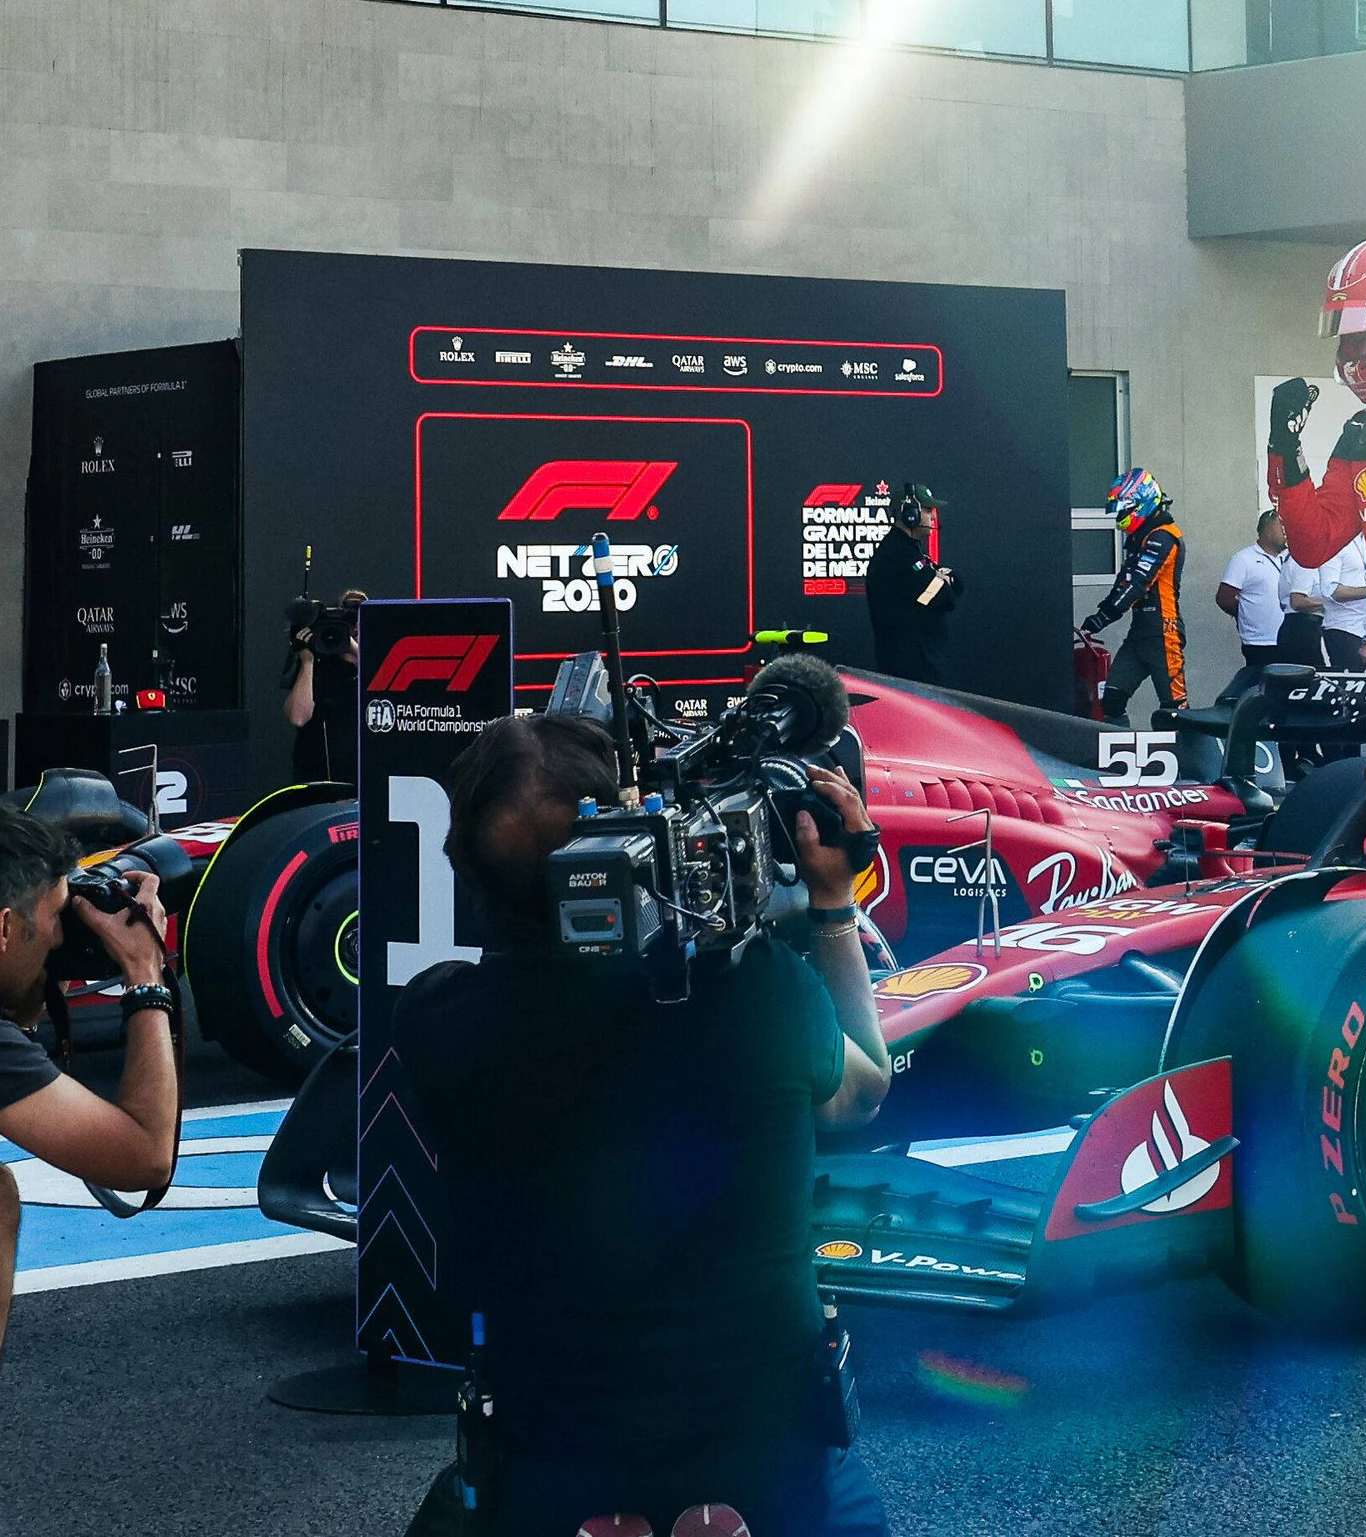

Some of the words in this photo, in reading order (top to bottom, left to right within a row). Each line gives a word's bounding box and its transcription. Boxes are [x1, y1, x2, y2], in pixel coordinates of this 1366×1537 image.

[440, 351, 475, 362] ROLEX
[607, 356, 653, 368] DHL
[671, 355, 705, 367] QATAR
[723, 355, 747, 368] aws
[777, 362, 822, 374] crypto.com
[853, 362, 878, 375] MSC
[81, 459, 116, 474] ROLEX
[802, 507, 889, 524] FORMULA
[80, 533, 114, 545] Heineken
[803, 525, 854, 542] GRAN
[803, 543, 827, 560] DE
[828, 543, 853, 560] LA
[497, 544, 577, 578] NET
[803, 561, 827, 578] DE
[77, 606, 114, 625] QATAR
[396, 704, 411, 717] FIA
[413, 704, 455, 717] Formula
[675, 699, 708, 711] QATAR
[396, 718, 424, 732] World
[1098, 731, 1179, 788] 55
[155, 770, 188, 814] 2
[1075, 788, 1210, 813] Santander
[568, 872, 608, 881] ANTON
[1319, 1000, 1366, 1177] ZERO
